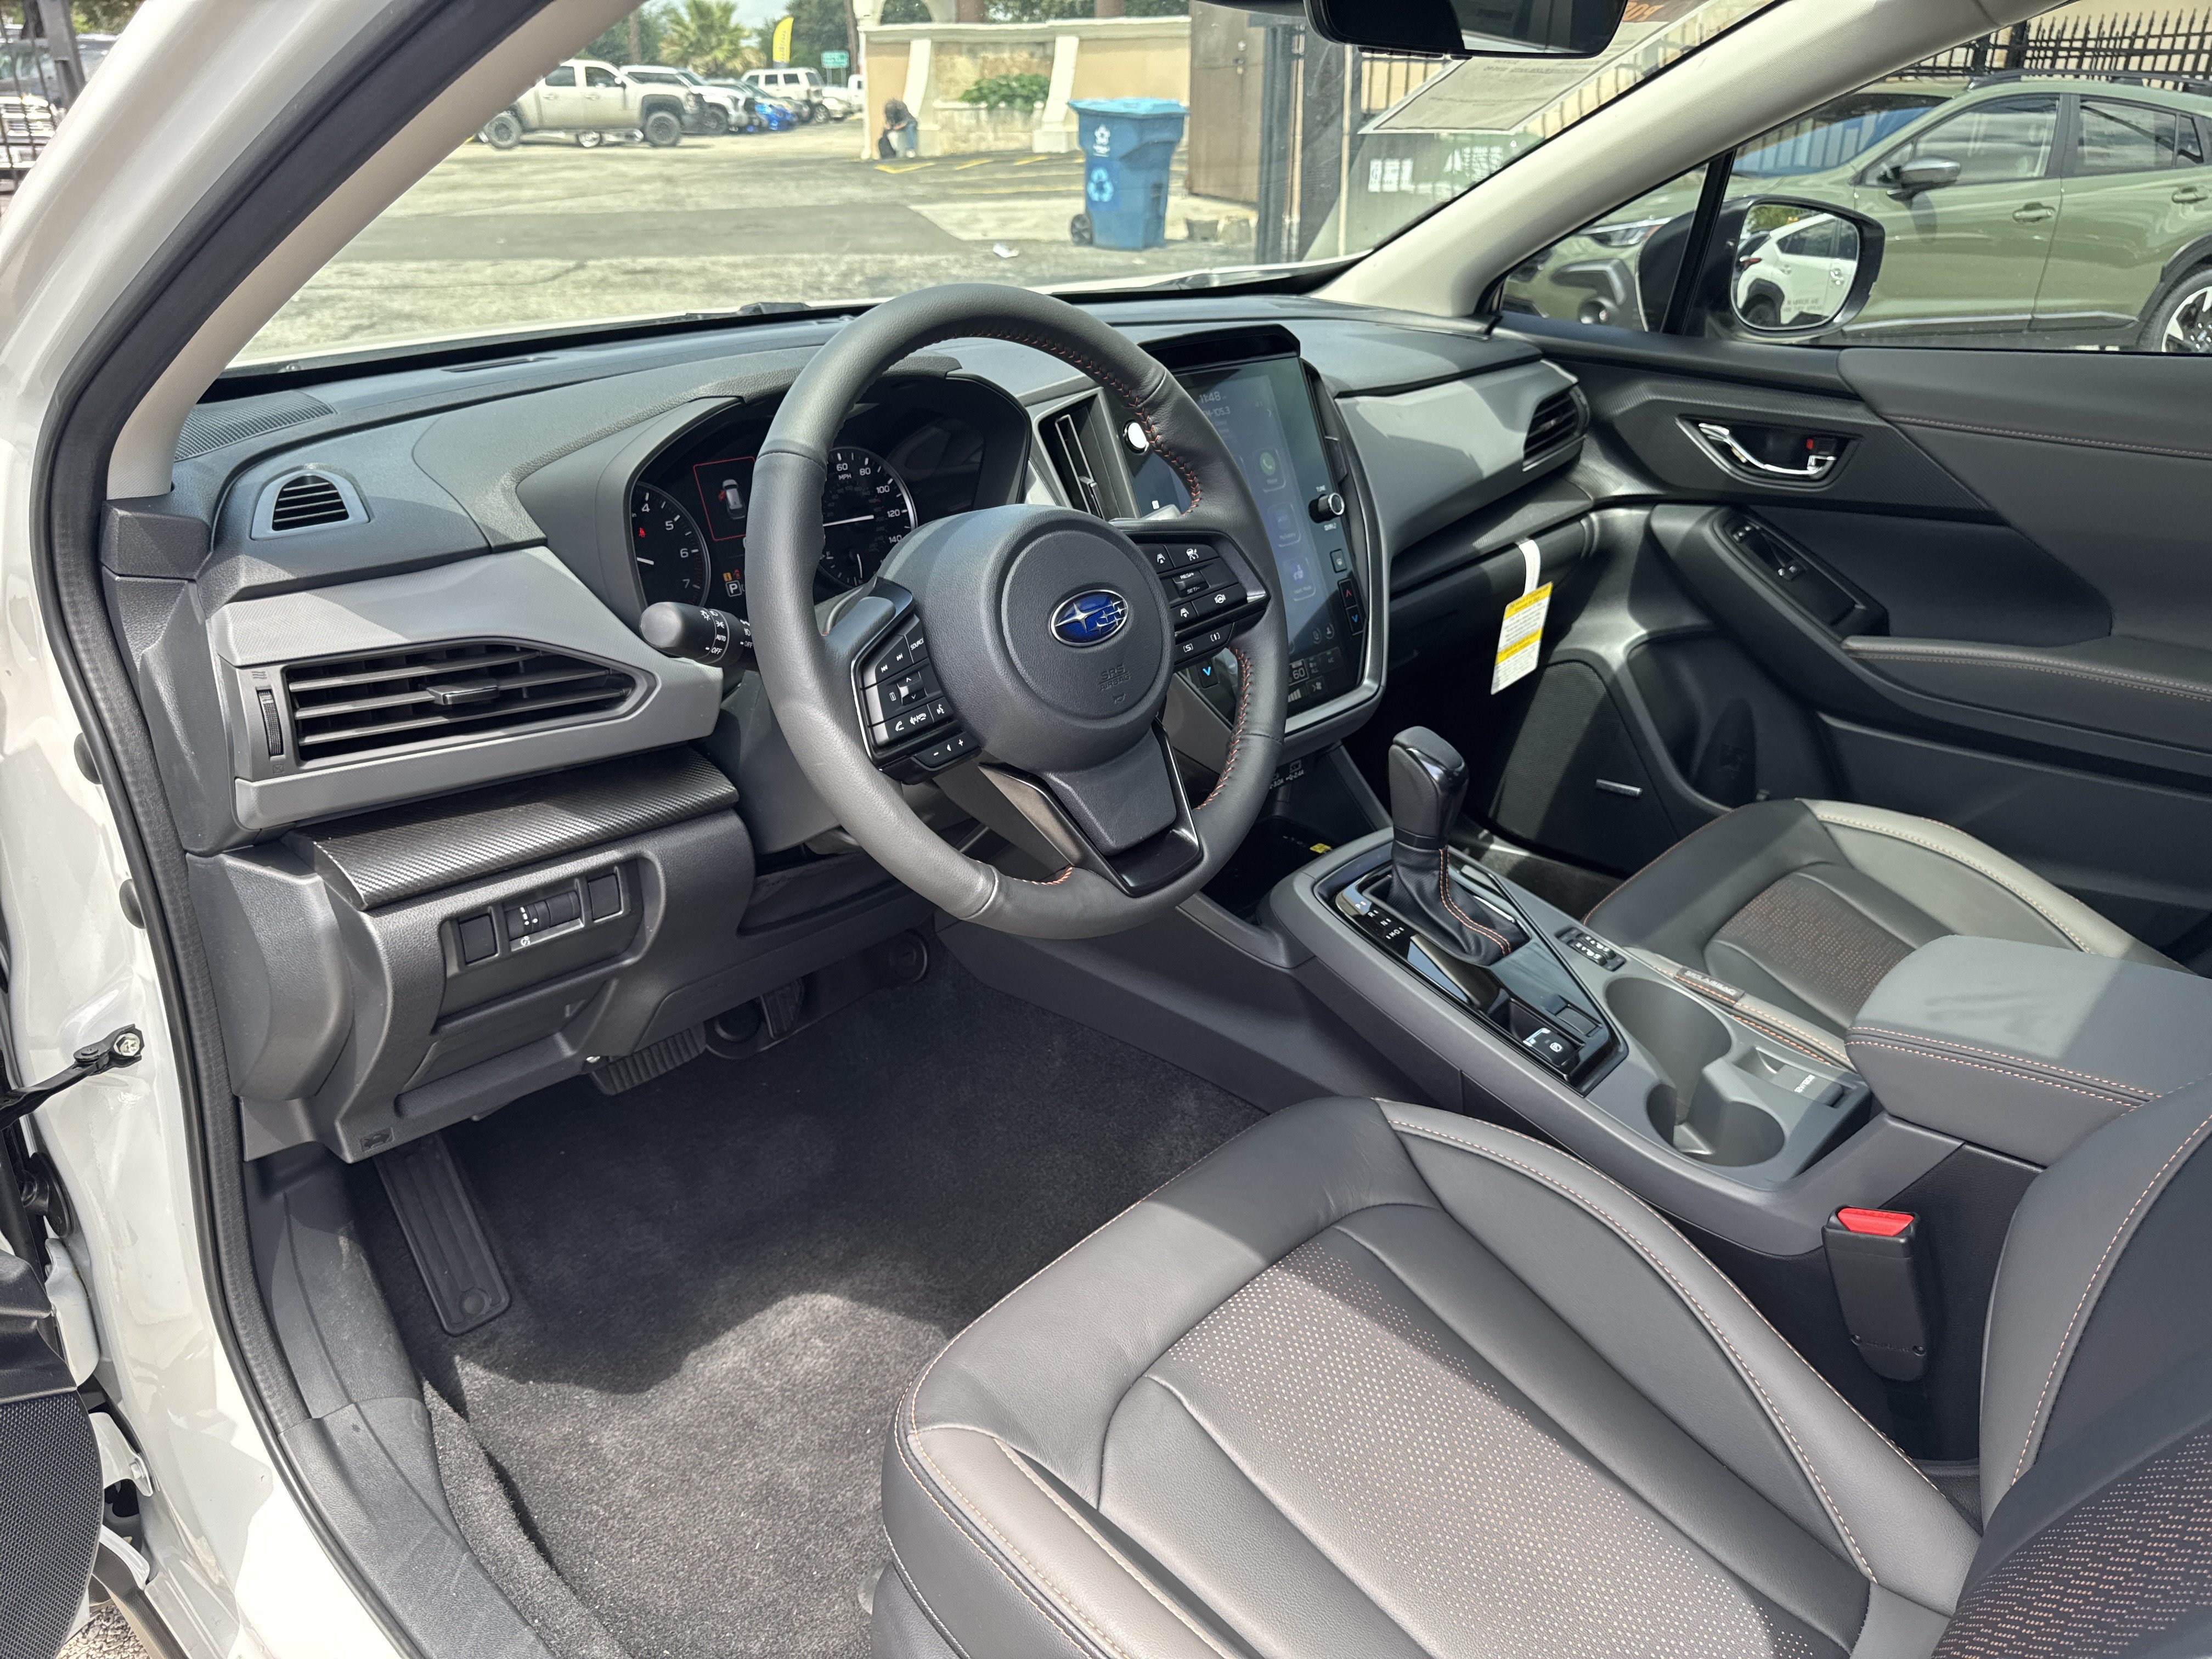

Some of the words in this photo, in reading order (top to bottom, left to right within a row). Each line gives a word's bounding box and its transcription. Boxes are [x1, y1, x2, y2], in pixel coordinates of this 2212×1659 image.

[860, 467, 871, 476] 80
[641, 503, 650, 512] 4
[887, 509, 900, 517] 120
[665, 521, 674, 531] 5
[888, 535, 901, 543] 140
[680, 548, 689, 558] 6
[683, 579, 690, 589] 7
[730, 584, 738, 594] P
[711, 647, 723, 655] OFF
[1101, 664, 1125, 680] SRS
[1292, 668, 1305, 680] 60
[1100, 675, 1131, 691] AIRBAG
